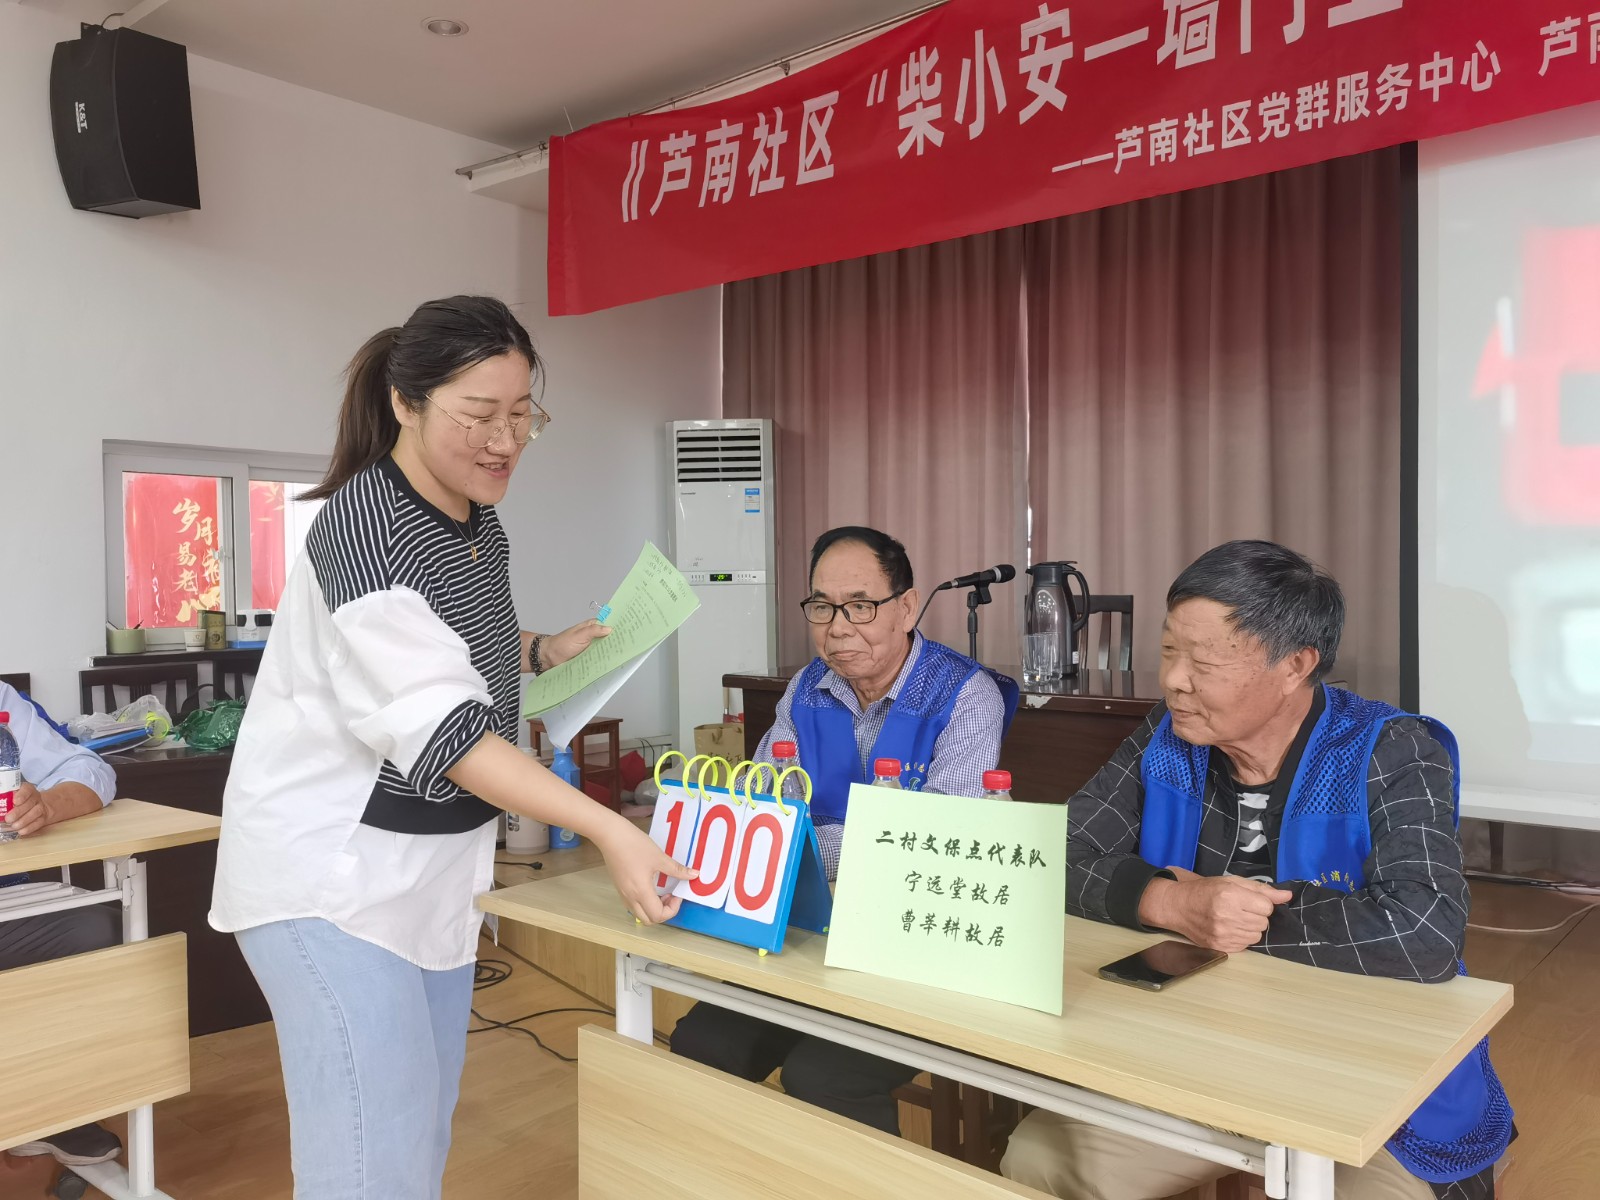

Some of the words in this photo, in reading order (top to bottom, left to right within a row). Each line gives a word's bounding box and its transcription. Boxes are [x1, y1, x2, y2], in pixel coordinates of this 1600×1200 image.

[656, 801, 783, 911] 100
[875, 830, 1047, 869] 二村文保点代表队
[904, 870, 1010, 906] 宁远堂故居
